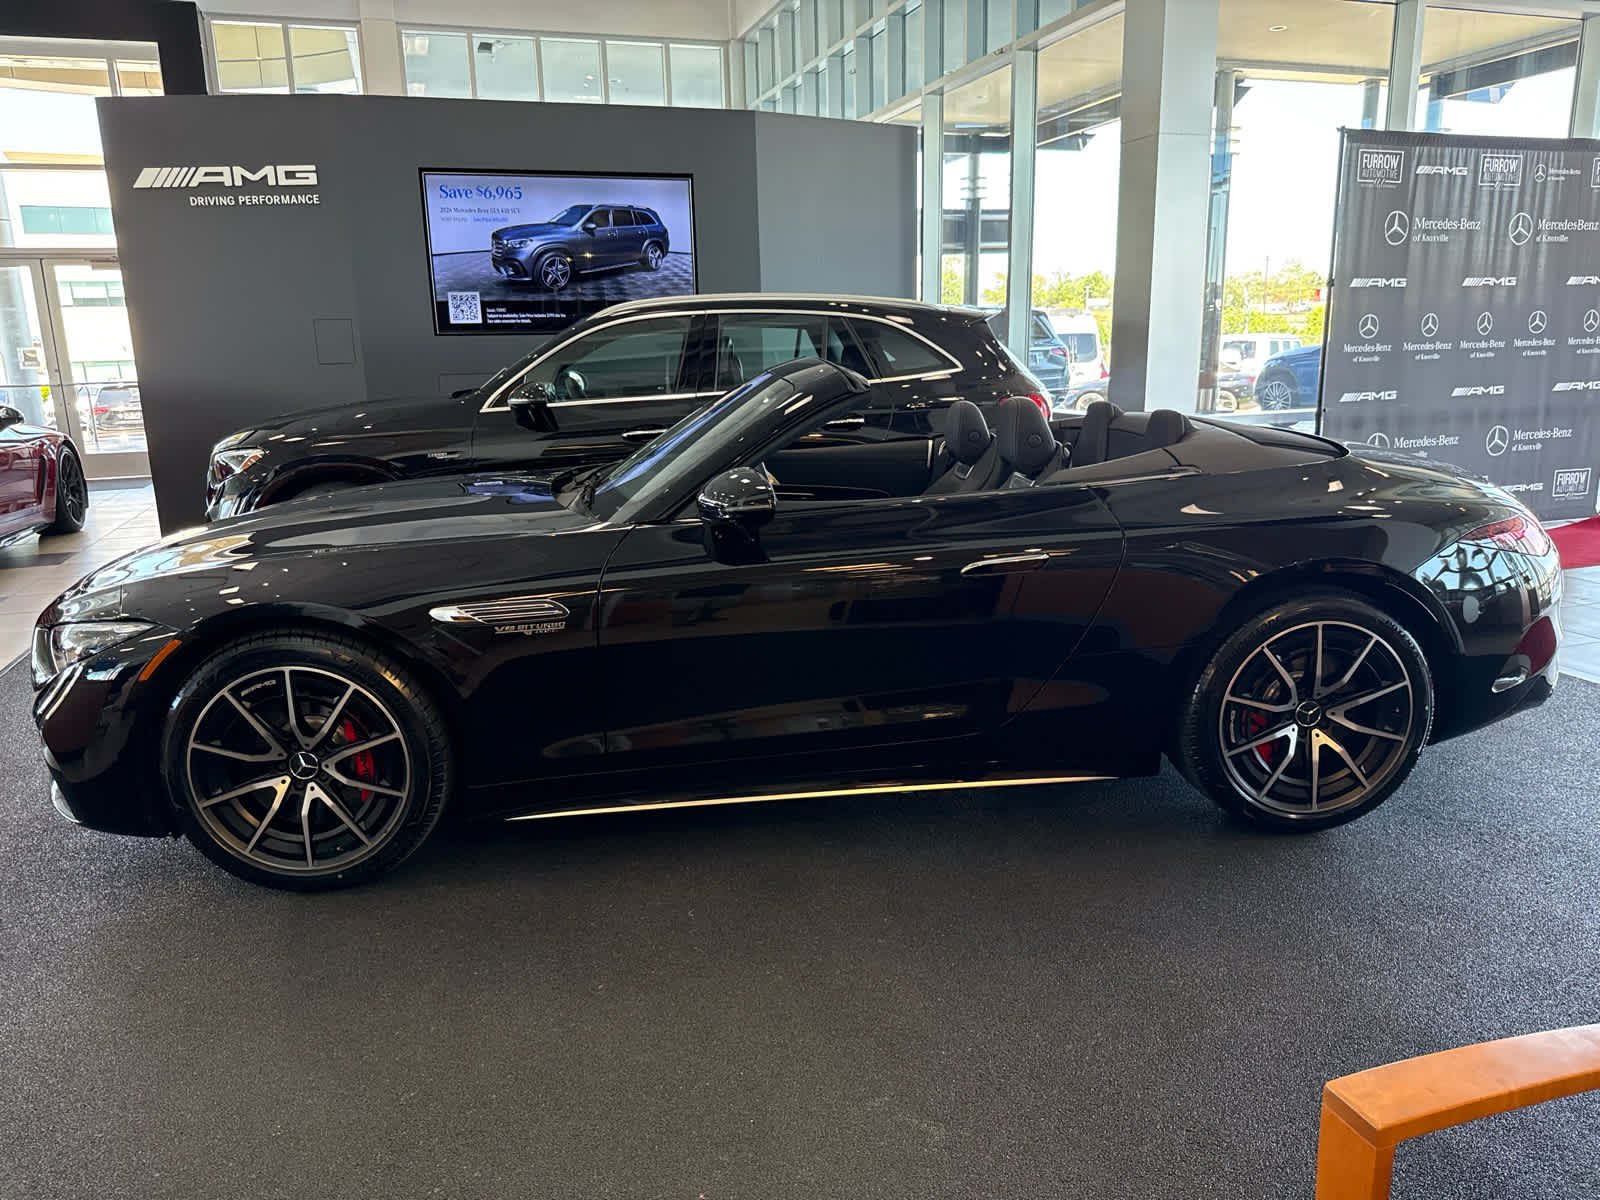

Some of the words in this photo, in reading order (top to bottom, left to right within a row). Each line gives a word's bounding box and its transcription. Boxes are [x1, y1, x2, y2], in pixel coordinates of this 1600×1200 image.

[1363, 153, 1400, 169] FURROW
[1484, 158, 1518, 173] FURROW
[189, 165, 318, 187] AMG
[1430, 166, 1468, 176] AMG
[440, 184, 473, 199] Save
[476, 185, 522, 200] $6,965
[189, 196, 235, 206] DRIVING
[238, 194, 320, 206] PERFORMANCE
[1414, 217, 1481, 230] Mercedes-Benz
[1537, 218, 1600, 231] MercedesBenz
[1412, 234, 1421, 242] of
[1366, 278, 1407, 287] AMG
[1479, 276, 1517, 286] AMG
[1567, 336, 1600, 346] Mercedes-B
[1357, 390, 1398, 401] AMG
[1467, 385, 1505, 396] AMG
[1513, 427, 1573, 441] Mercedes-Benz
[1394, 434, 1459, 449] Mercedes-Benz
